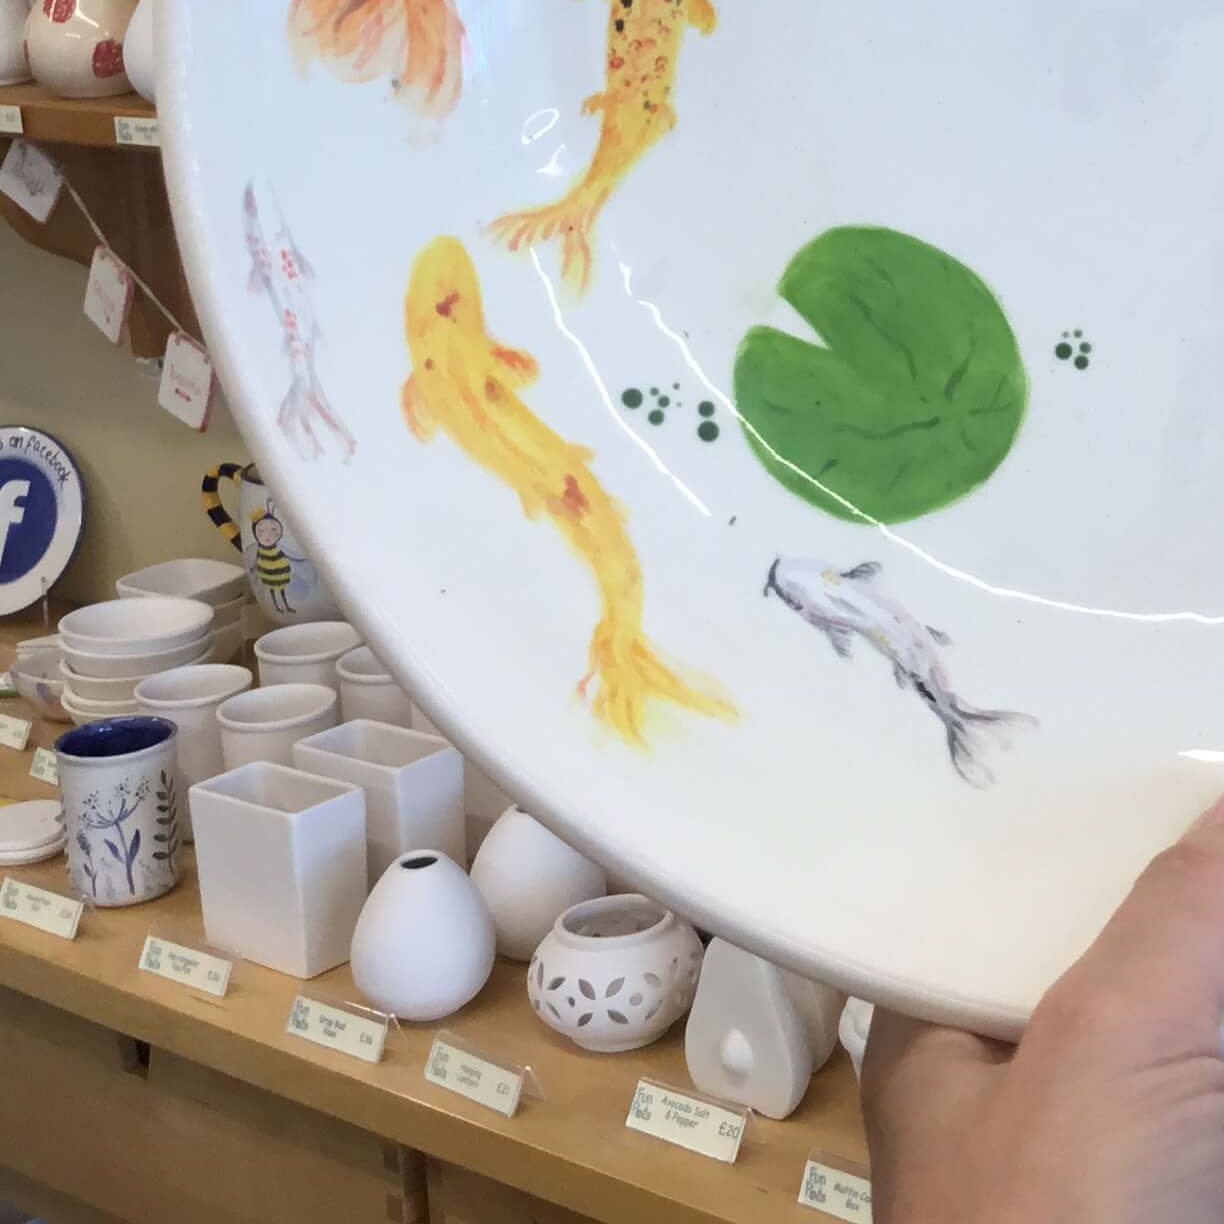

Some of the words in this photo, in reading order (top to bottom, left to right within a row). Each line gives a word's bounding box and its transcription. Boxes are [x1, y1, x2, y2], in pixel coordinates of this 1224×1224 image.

[661, 1095, 692, 1114] Avocado
[693, 1106, 711, 1119] Salt
[671, 1111, 700, 1129] Pepper
[718, 1121, 740, 1139] £20
